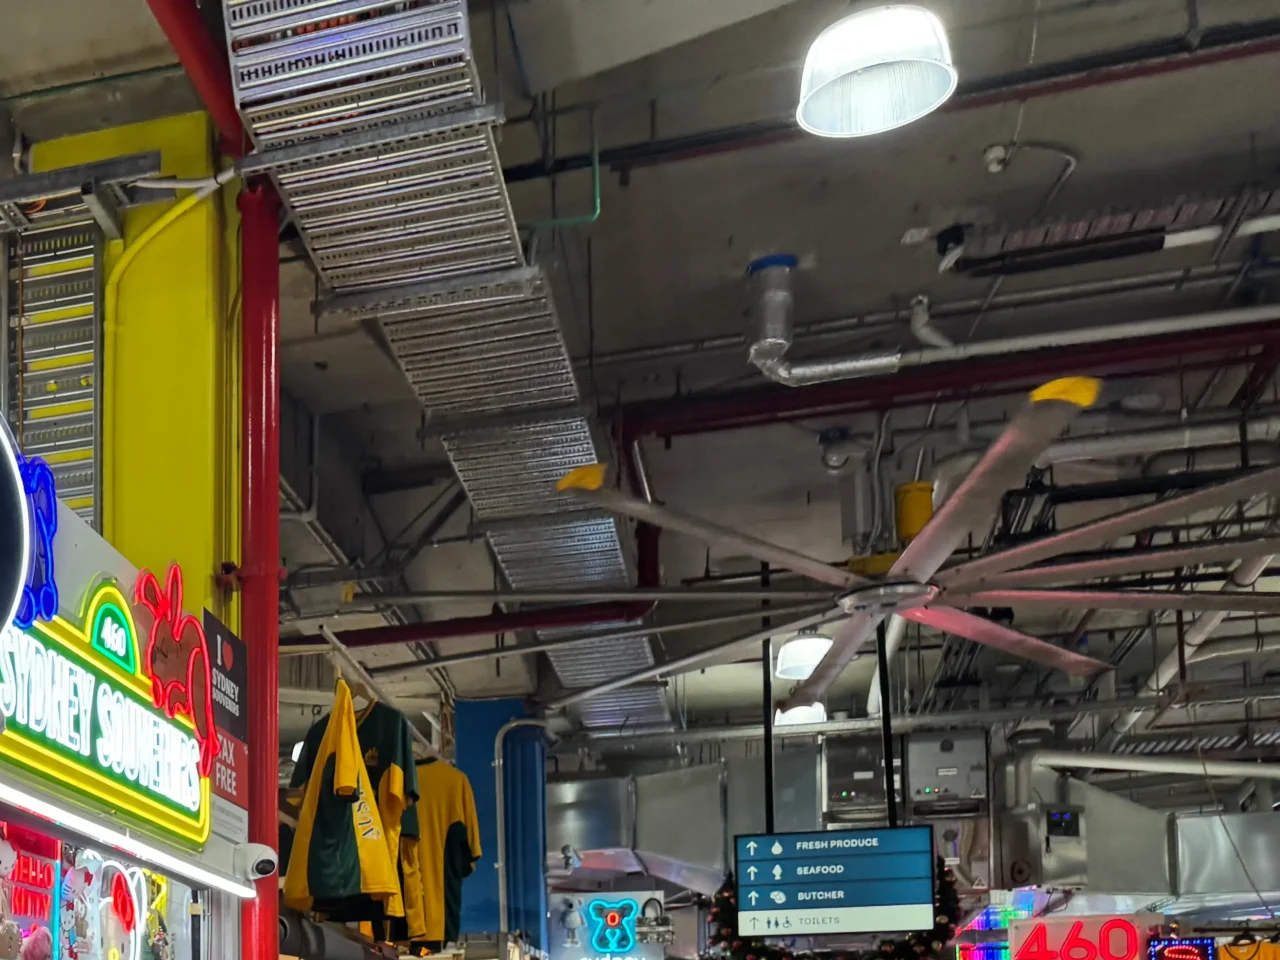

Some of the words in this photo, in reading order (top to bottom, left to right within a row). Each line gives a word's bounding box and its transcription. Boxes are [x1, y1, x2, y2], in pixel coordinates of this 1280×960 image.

[100, 616, 127, 657] 460
[216, 634, 222, 666] I
[212, 667, 240, 700] SYDNEY
[212, 689, 240, 717] SOUVENIRS
[96, 682, 200, 811] SOUVENIRS
[217, 733, 235, 767] TAX
[215, 763, 237, 796] FREE
[796, 841, 828, 850] FRESH
[830, 838, 879, 849] PRODUCE
[796, 865, 844, 876] SEAFOOD
[797, 890, 845, 901] BUTCHER
[799, 916, 840, 925] TOILETS
